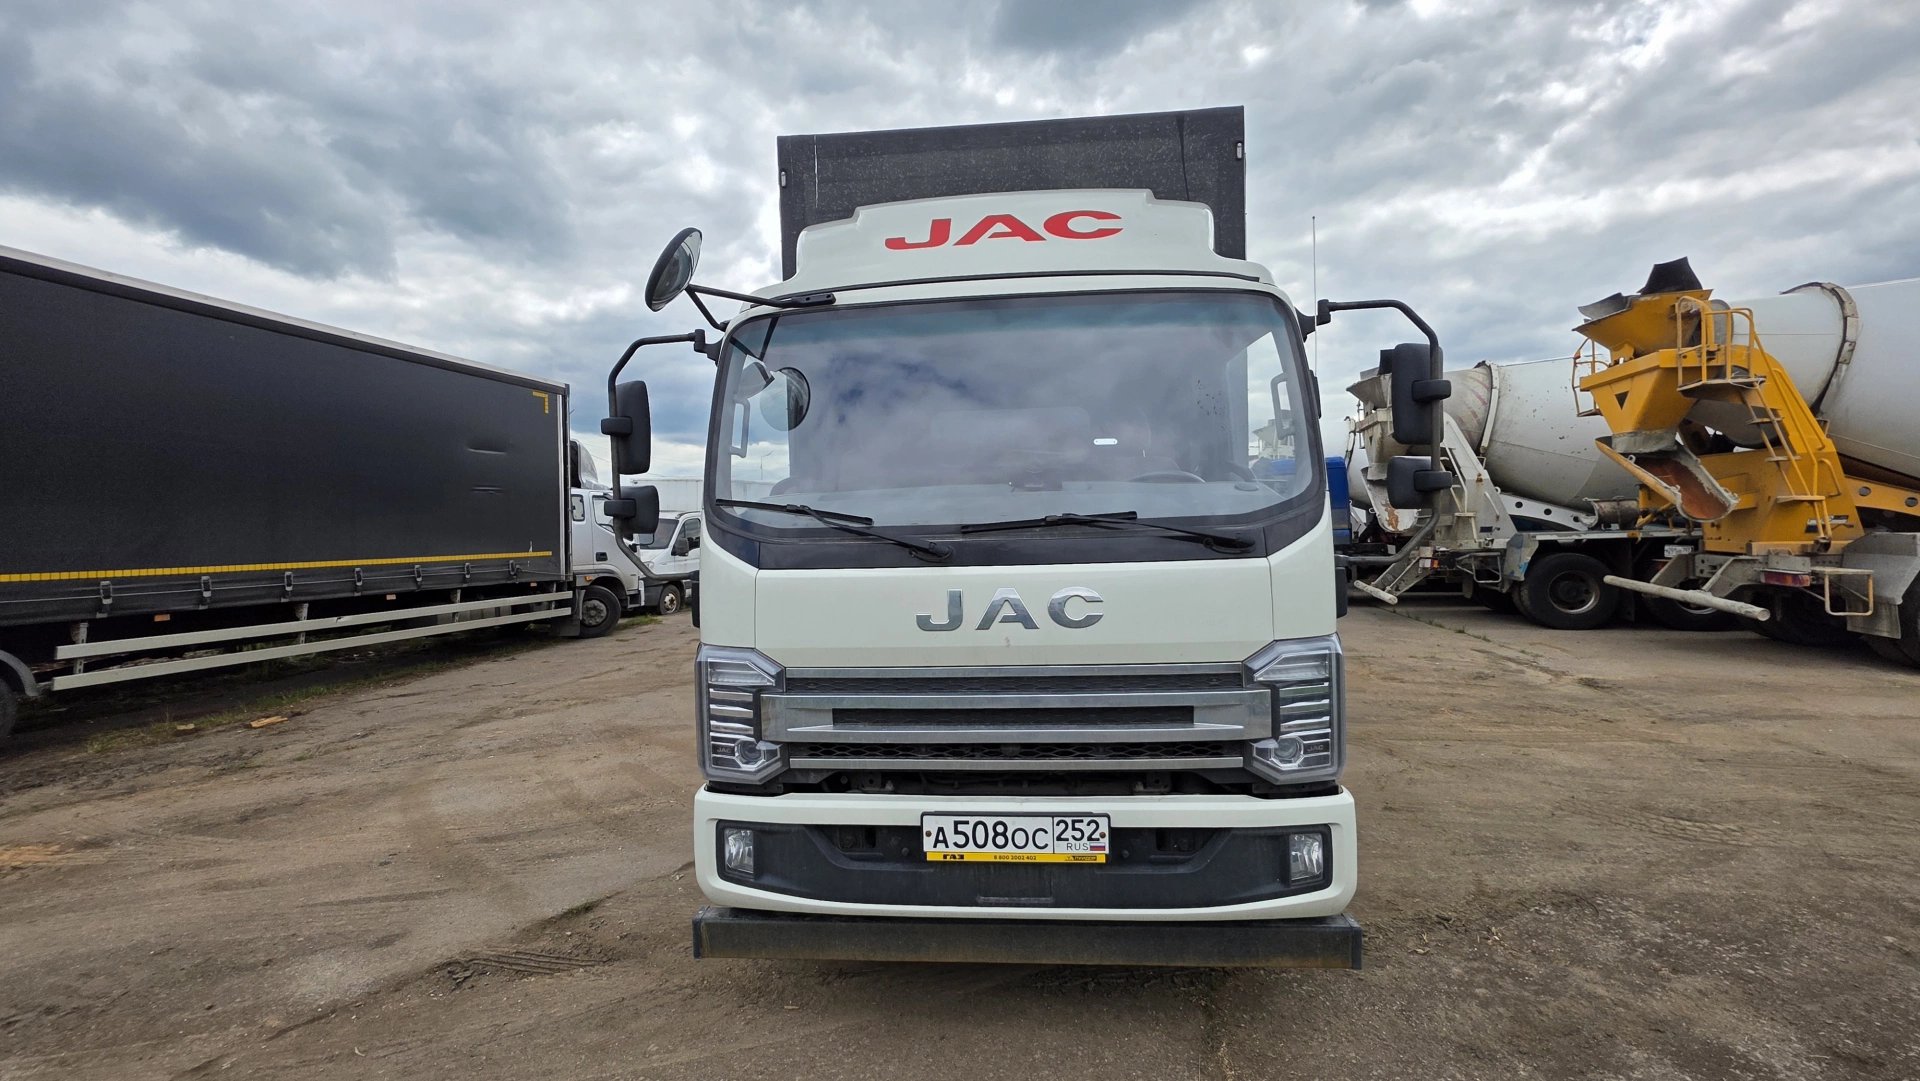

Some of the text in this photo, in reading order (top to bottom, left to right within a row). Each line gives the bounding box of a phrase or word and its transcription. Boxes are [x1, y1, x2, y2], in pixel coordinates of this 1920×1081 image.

[884, 210, 1124, 250] JAC
[916, 586, 1104, 631] JAC
[932, 819, 1100, 849] А508ОС 252
[1066, 842, 1089, 851] RUS
